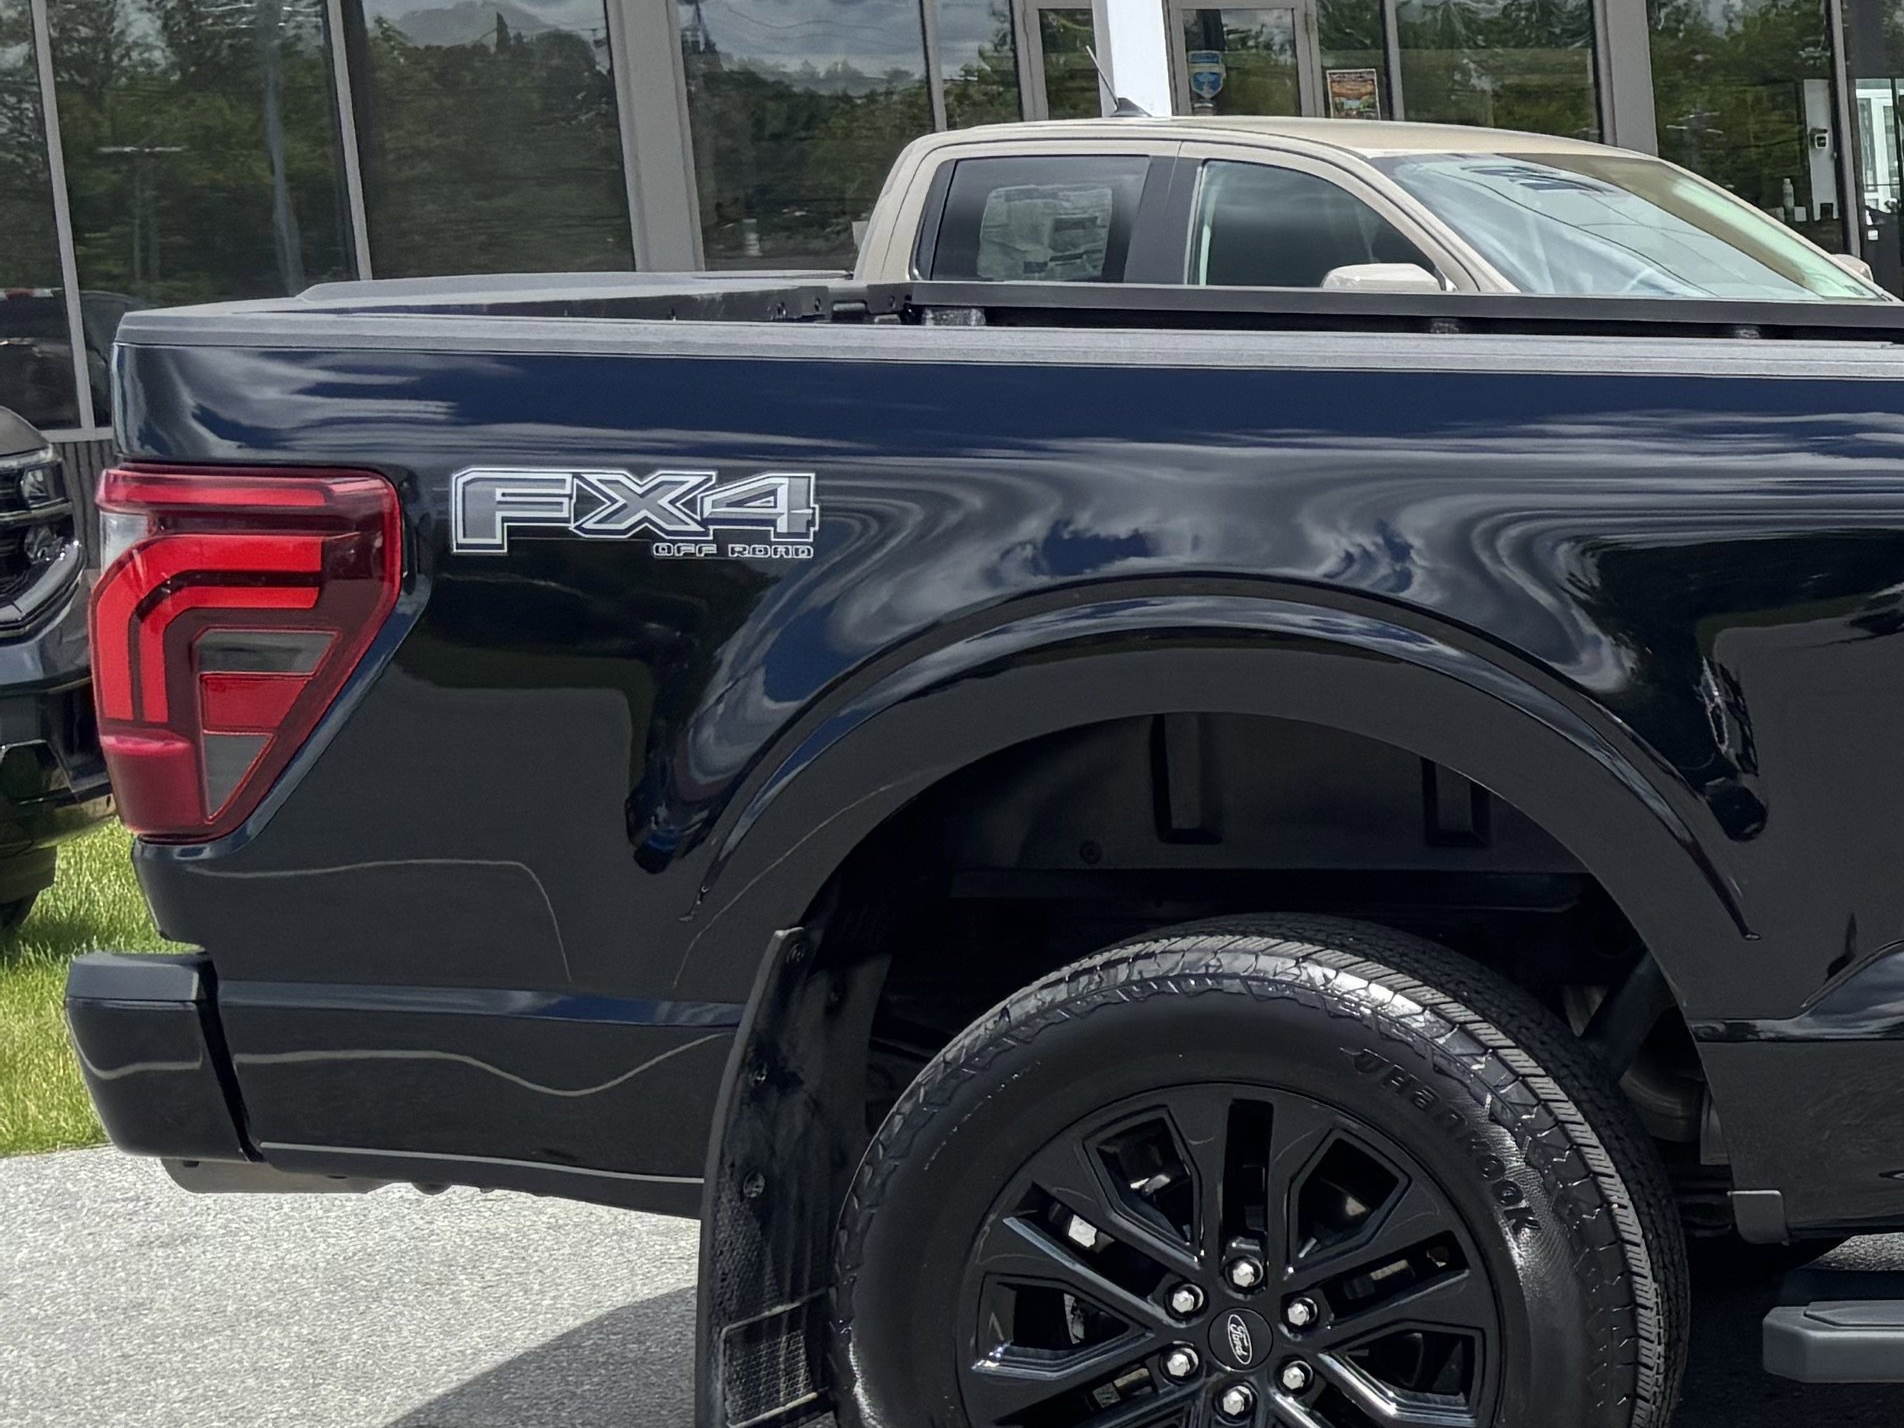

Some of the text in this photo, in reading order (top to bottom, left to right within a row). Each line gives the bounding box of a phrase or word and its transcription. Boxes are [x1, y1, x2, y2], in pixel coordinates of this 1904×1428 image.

[452, 467, 819, 555] FX4
[652, 542, 814, 559] OFF ROAD
